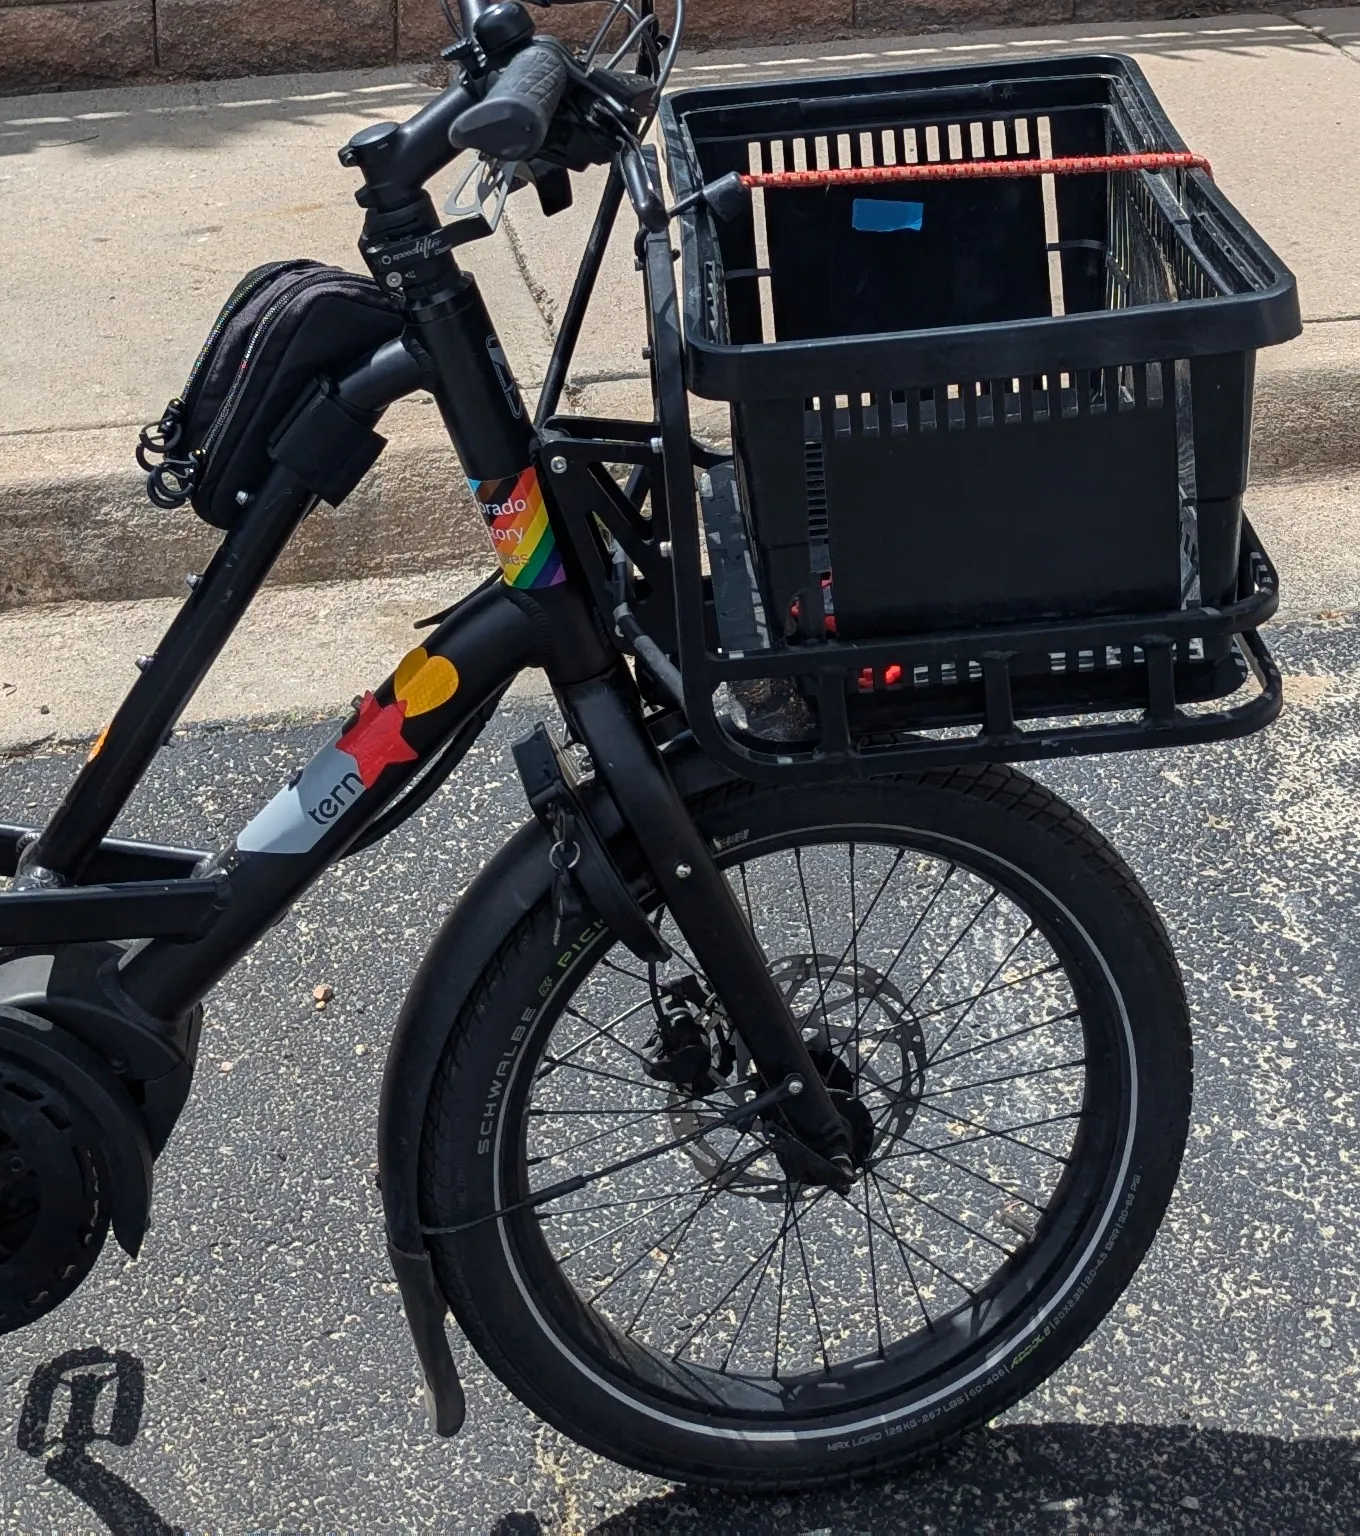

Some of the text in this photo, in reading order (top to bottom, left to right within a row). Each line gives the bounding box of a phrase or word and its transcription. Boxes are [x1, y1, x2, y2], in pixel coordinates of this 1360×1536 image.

[307, 772, 365, 825] tern
[477, 1005, 537, 1156] SCHWALBE
[851, 1432, 882, 1447] LOAD
